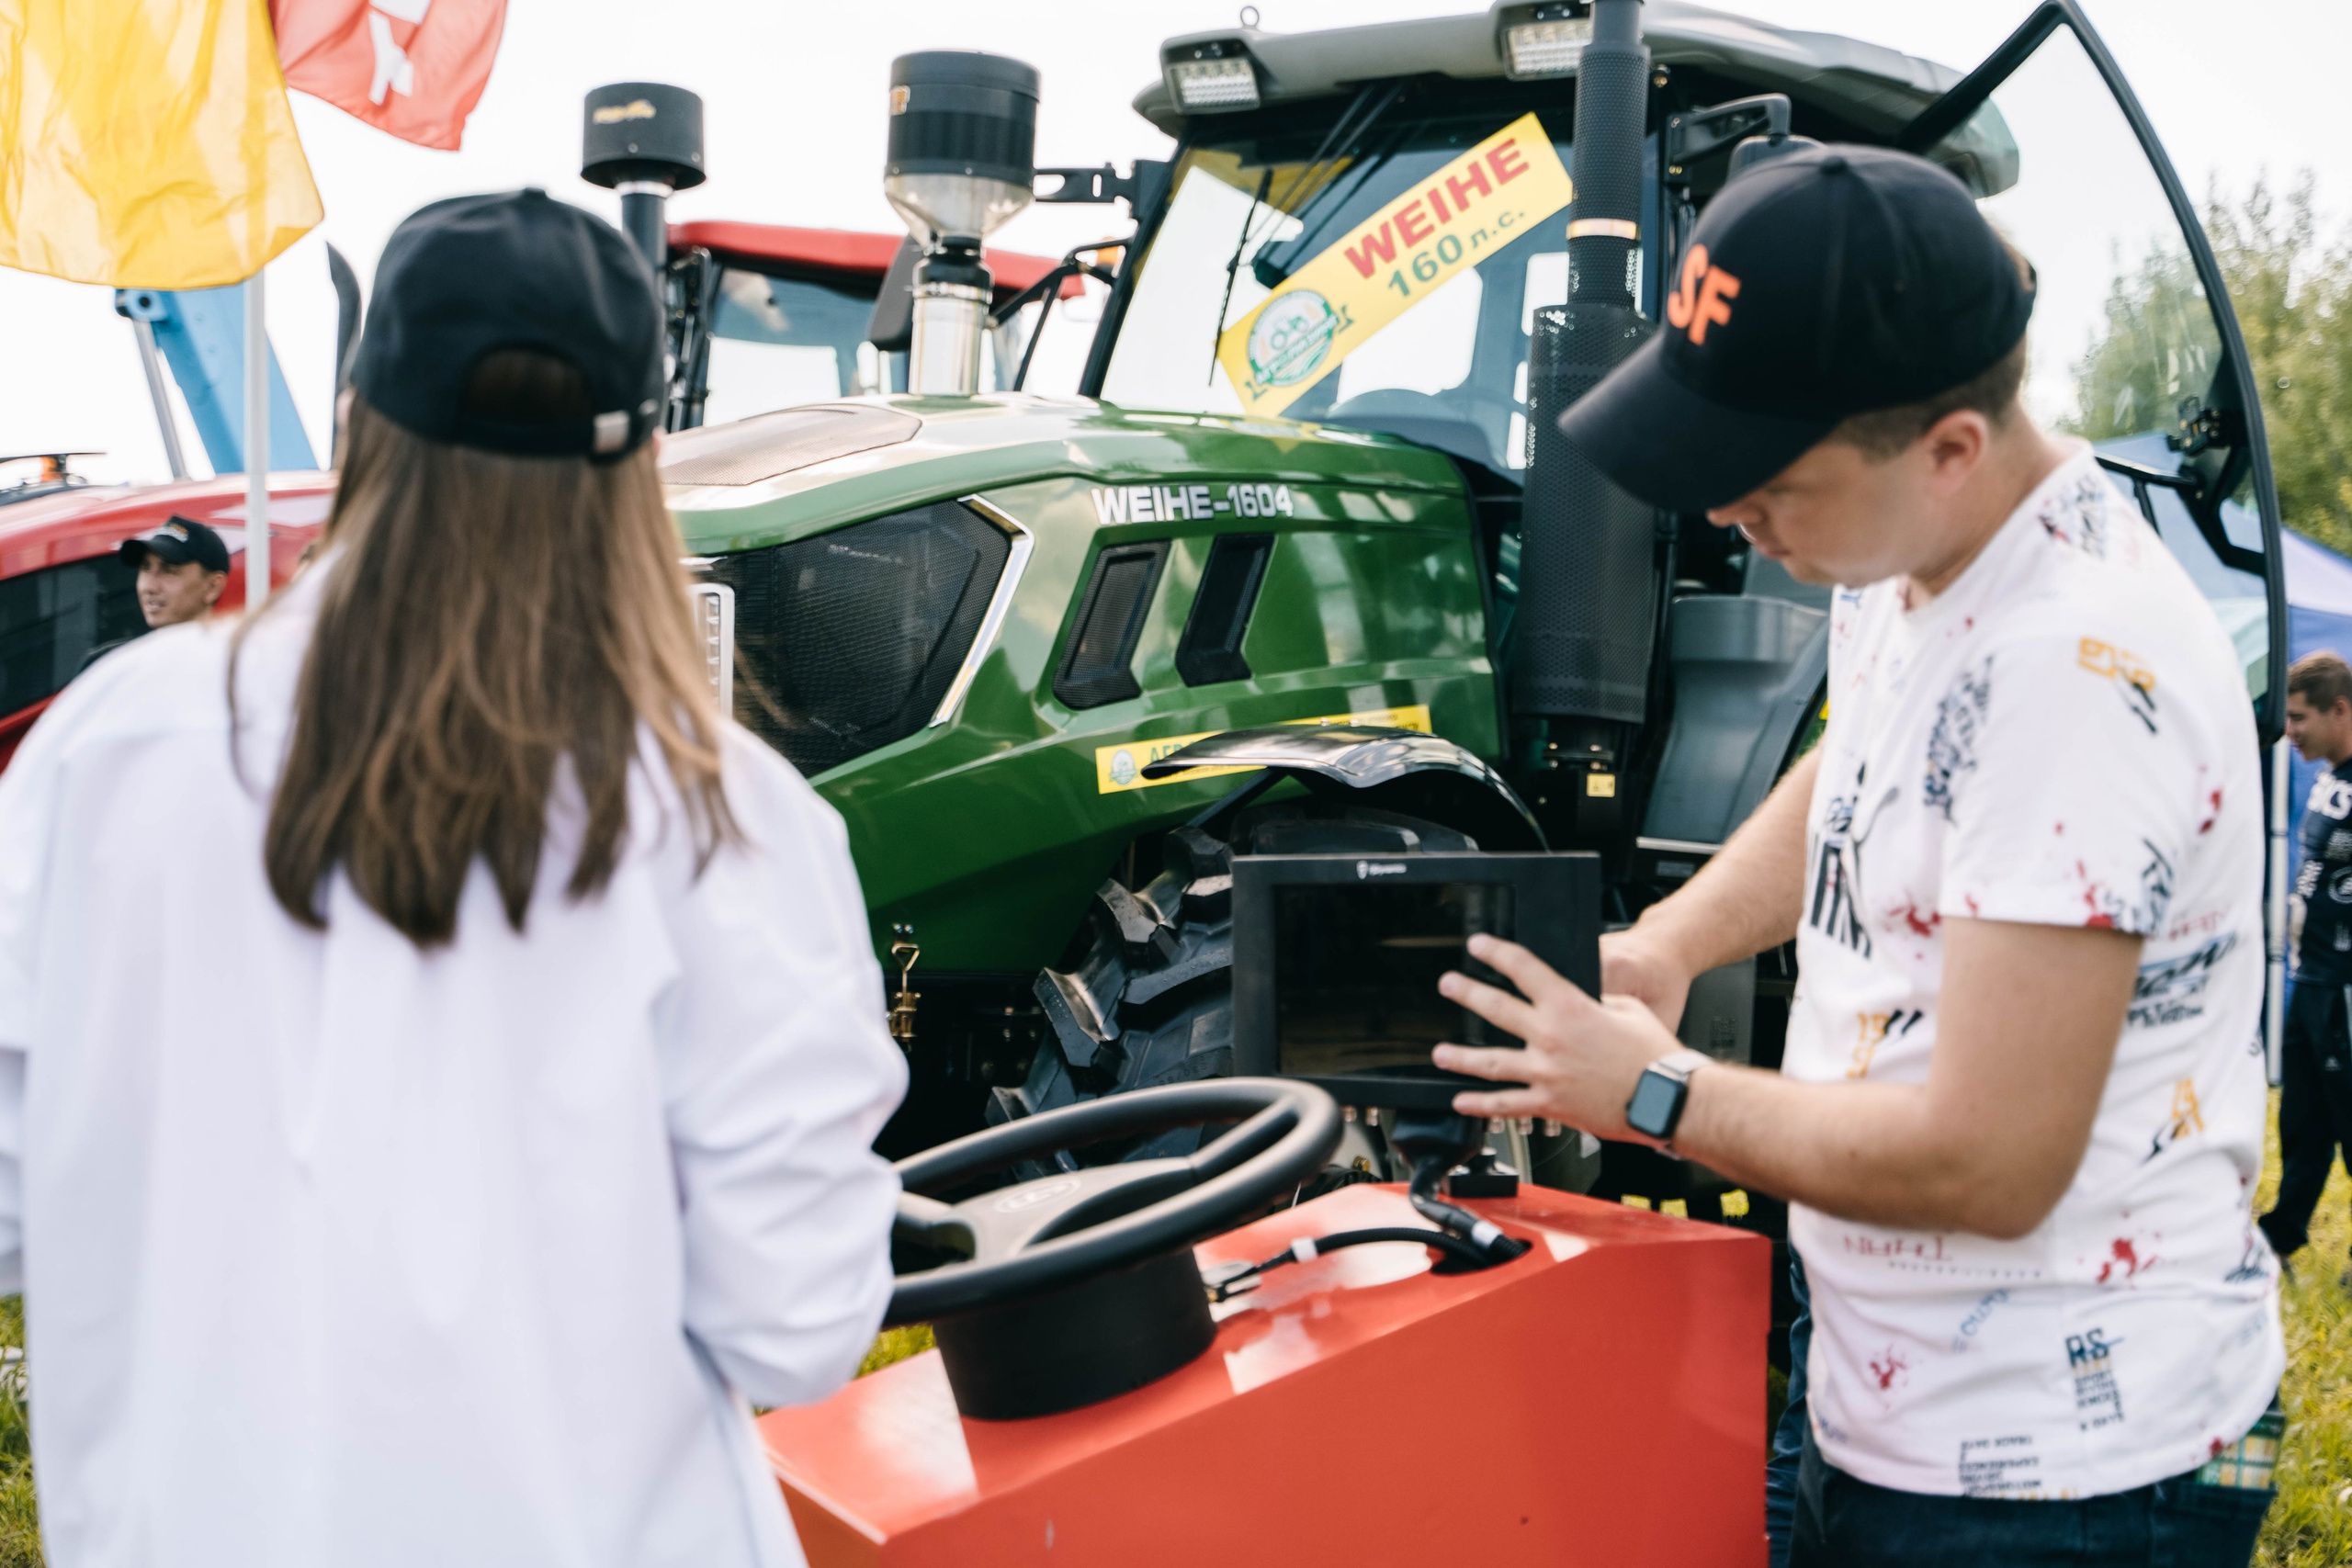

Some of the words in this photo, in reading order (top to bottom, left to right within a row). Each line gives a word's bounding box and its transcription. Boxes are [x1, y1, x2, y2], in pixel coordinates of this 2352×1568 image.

[1343, 138, 1530, 280] WEIHE
[1388, 234, 1463, 298] 160
[1667, 243, 1741, 346] SF
[1091, 483, 1294, 525] WEIHE-1604
